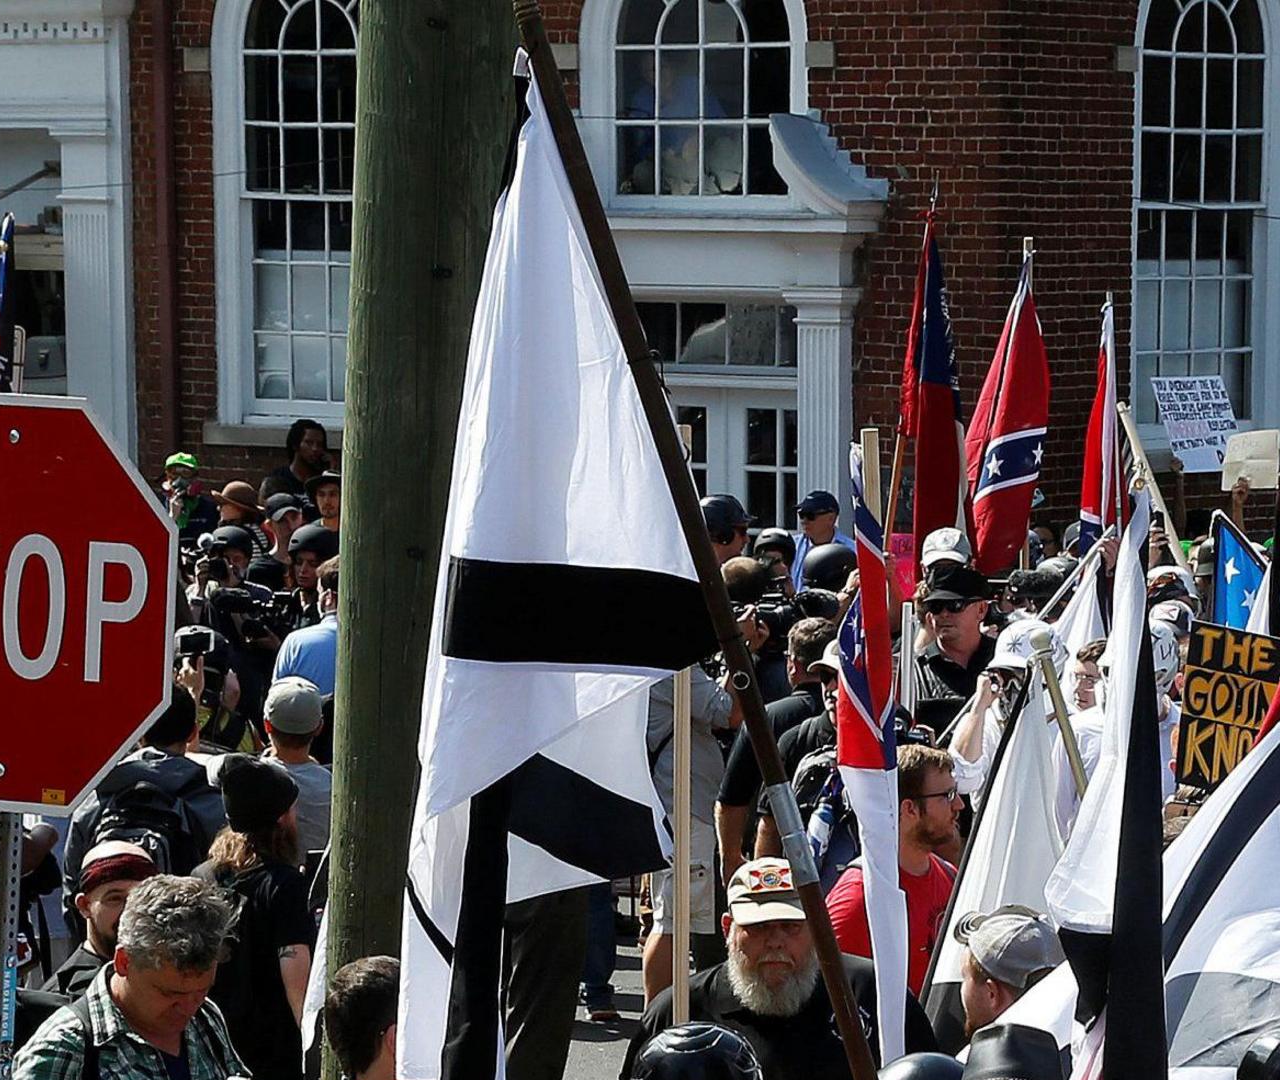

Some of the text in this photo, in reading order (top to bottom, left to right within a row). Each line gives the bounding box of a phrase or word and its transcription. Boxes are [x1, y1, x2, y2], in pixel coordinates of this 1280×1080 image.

[1196, 628, 1276, 674] THE
[1182, 719, 1254, 784] KNO
[1, 970, 12, 1037] DOWNTOWN
